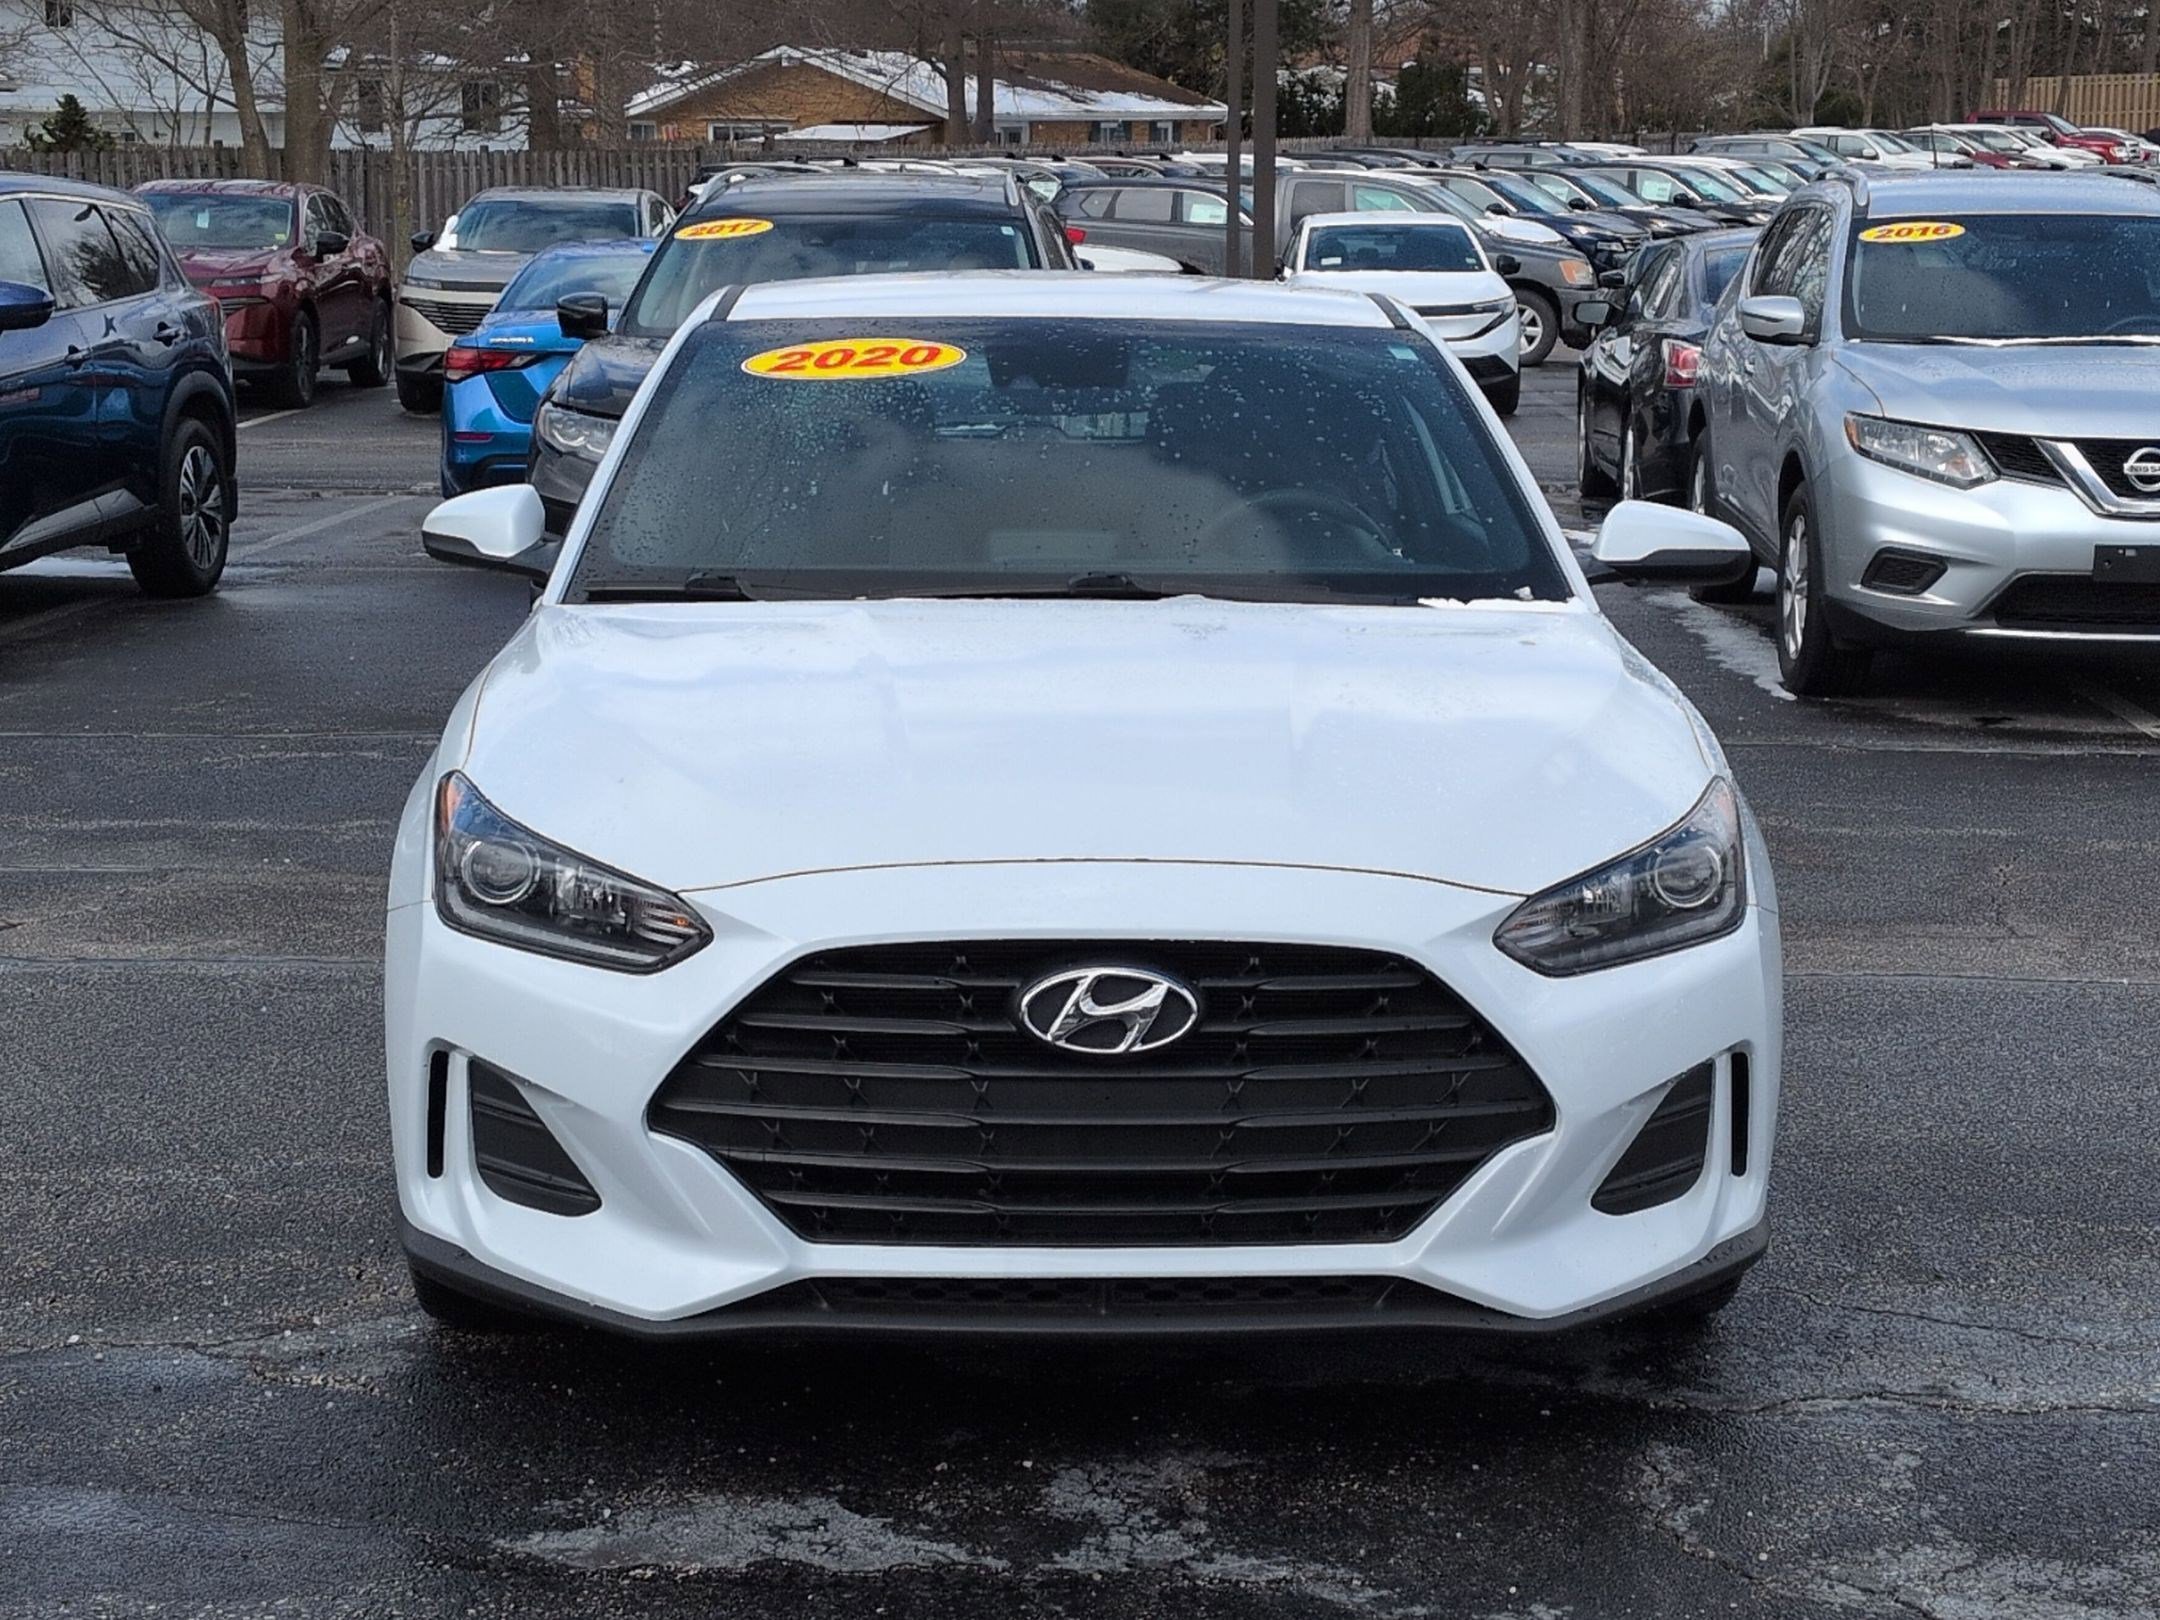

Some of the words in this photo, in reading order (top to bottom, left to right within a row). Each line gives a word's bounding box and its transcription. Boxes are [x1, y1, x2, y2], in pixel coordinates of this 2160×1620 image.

[686, 222, 763, 236] 2017
[1873, 226, 1952, 239] 2016
[767, 345, 942, 372] 2020
